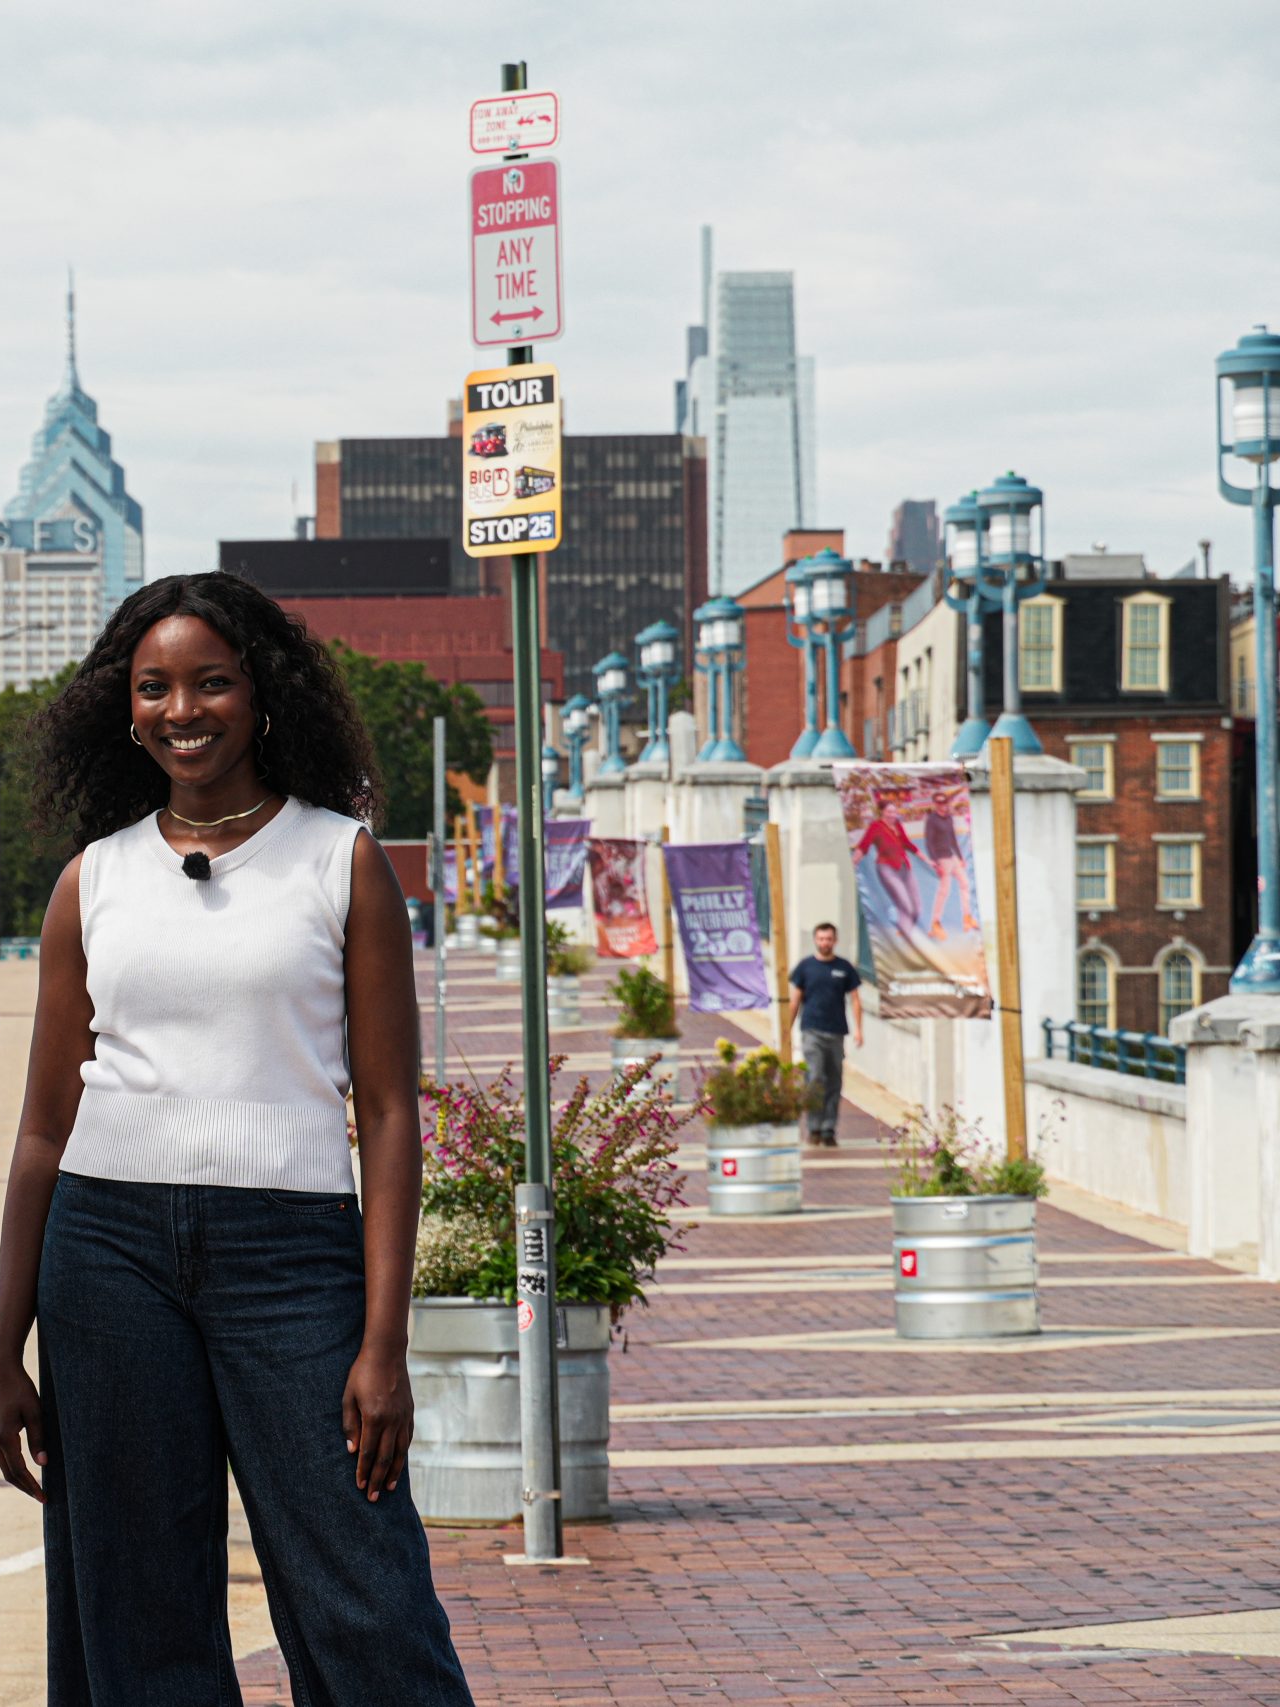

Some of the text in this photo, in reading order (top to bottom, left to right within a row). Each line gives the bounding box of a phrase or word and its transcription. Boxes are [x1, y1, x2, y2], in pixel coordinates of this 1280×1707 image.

[485, 120, 507, 132] ZONE
[503, 169, 524, 195] NO
[478, 196, 551, 228] STOPPING
[496, 236, 535, 268] ANY
[495, 269, 538, 301] TIME
[477, 378, 543, 409] TOUR
[470, 469, 492, 485] BIG
[470, 513, 552, 544] STOP 25
[680, 892, 746, 911] PHILLY
[683, 909, 751, 930] WATERFRONT
